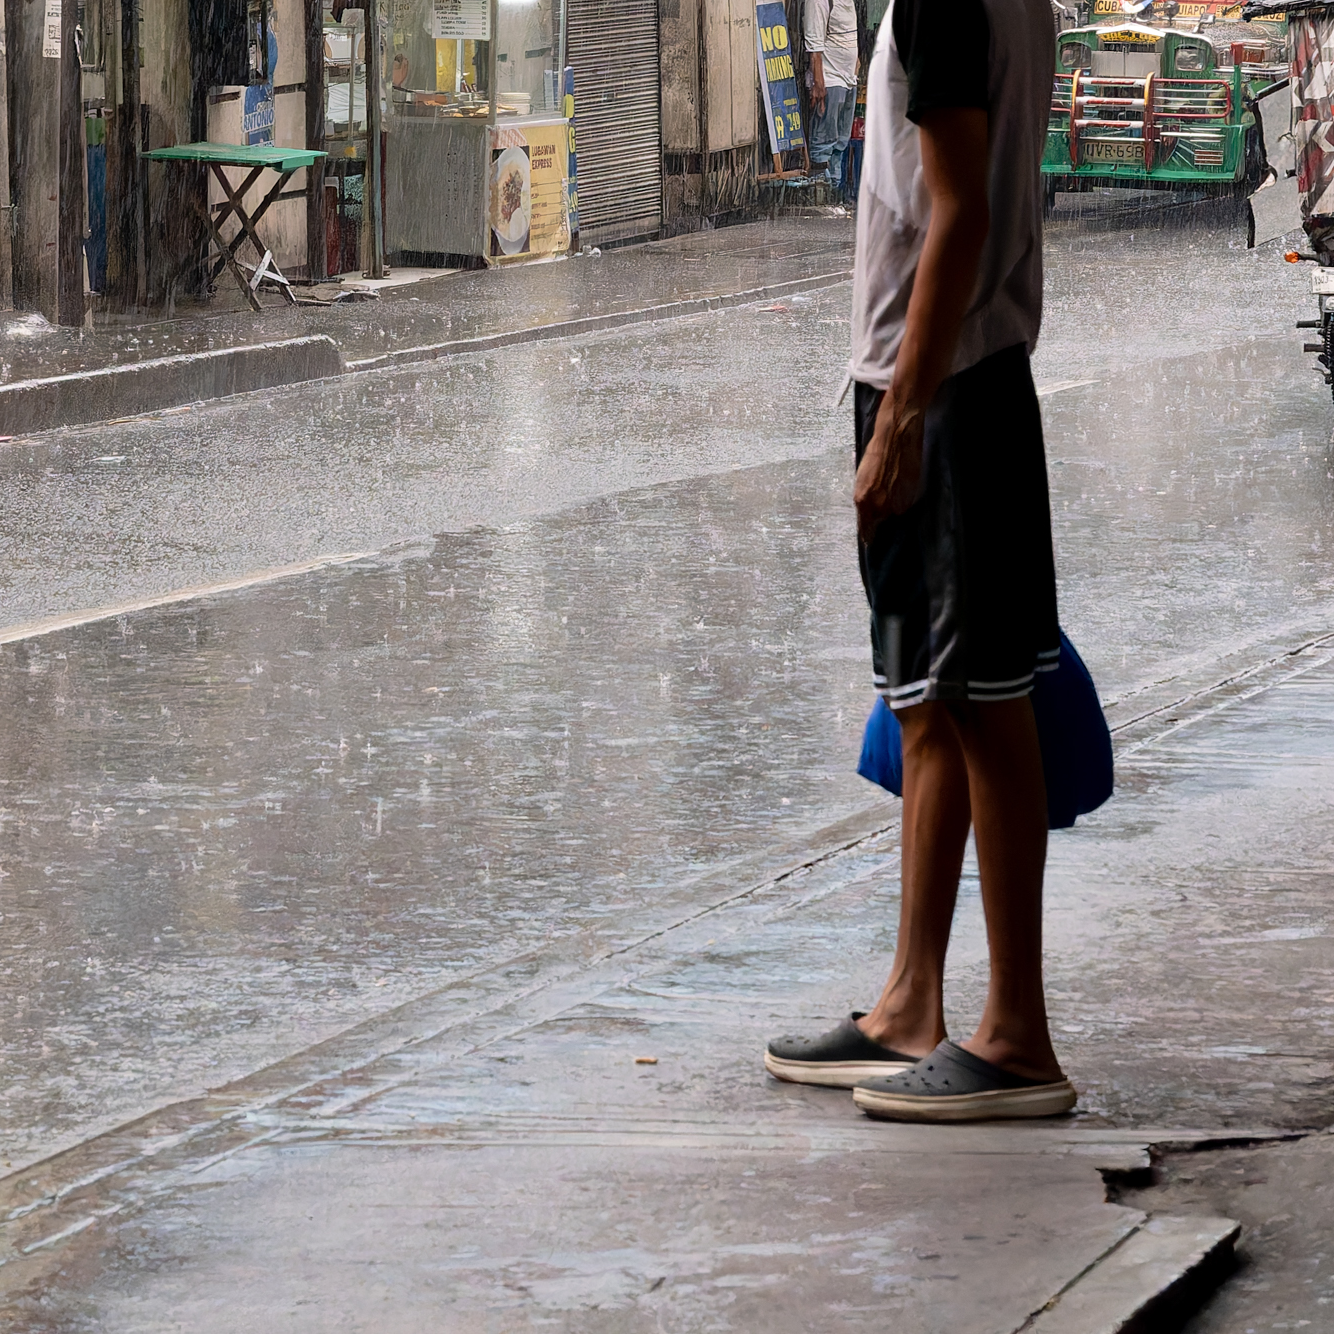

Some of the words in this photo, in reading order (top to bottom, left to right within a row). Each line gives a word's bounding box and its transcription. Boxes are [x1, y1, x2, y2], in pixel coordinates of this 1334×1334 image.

[1098, 0, 1124, 13] CUBA
[1177, 3, 1205, 16] UIAPO
[760, 25, 788, 52] NO
[244, 109, 274, 131] ANTONIO
